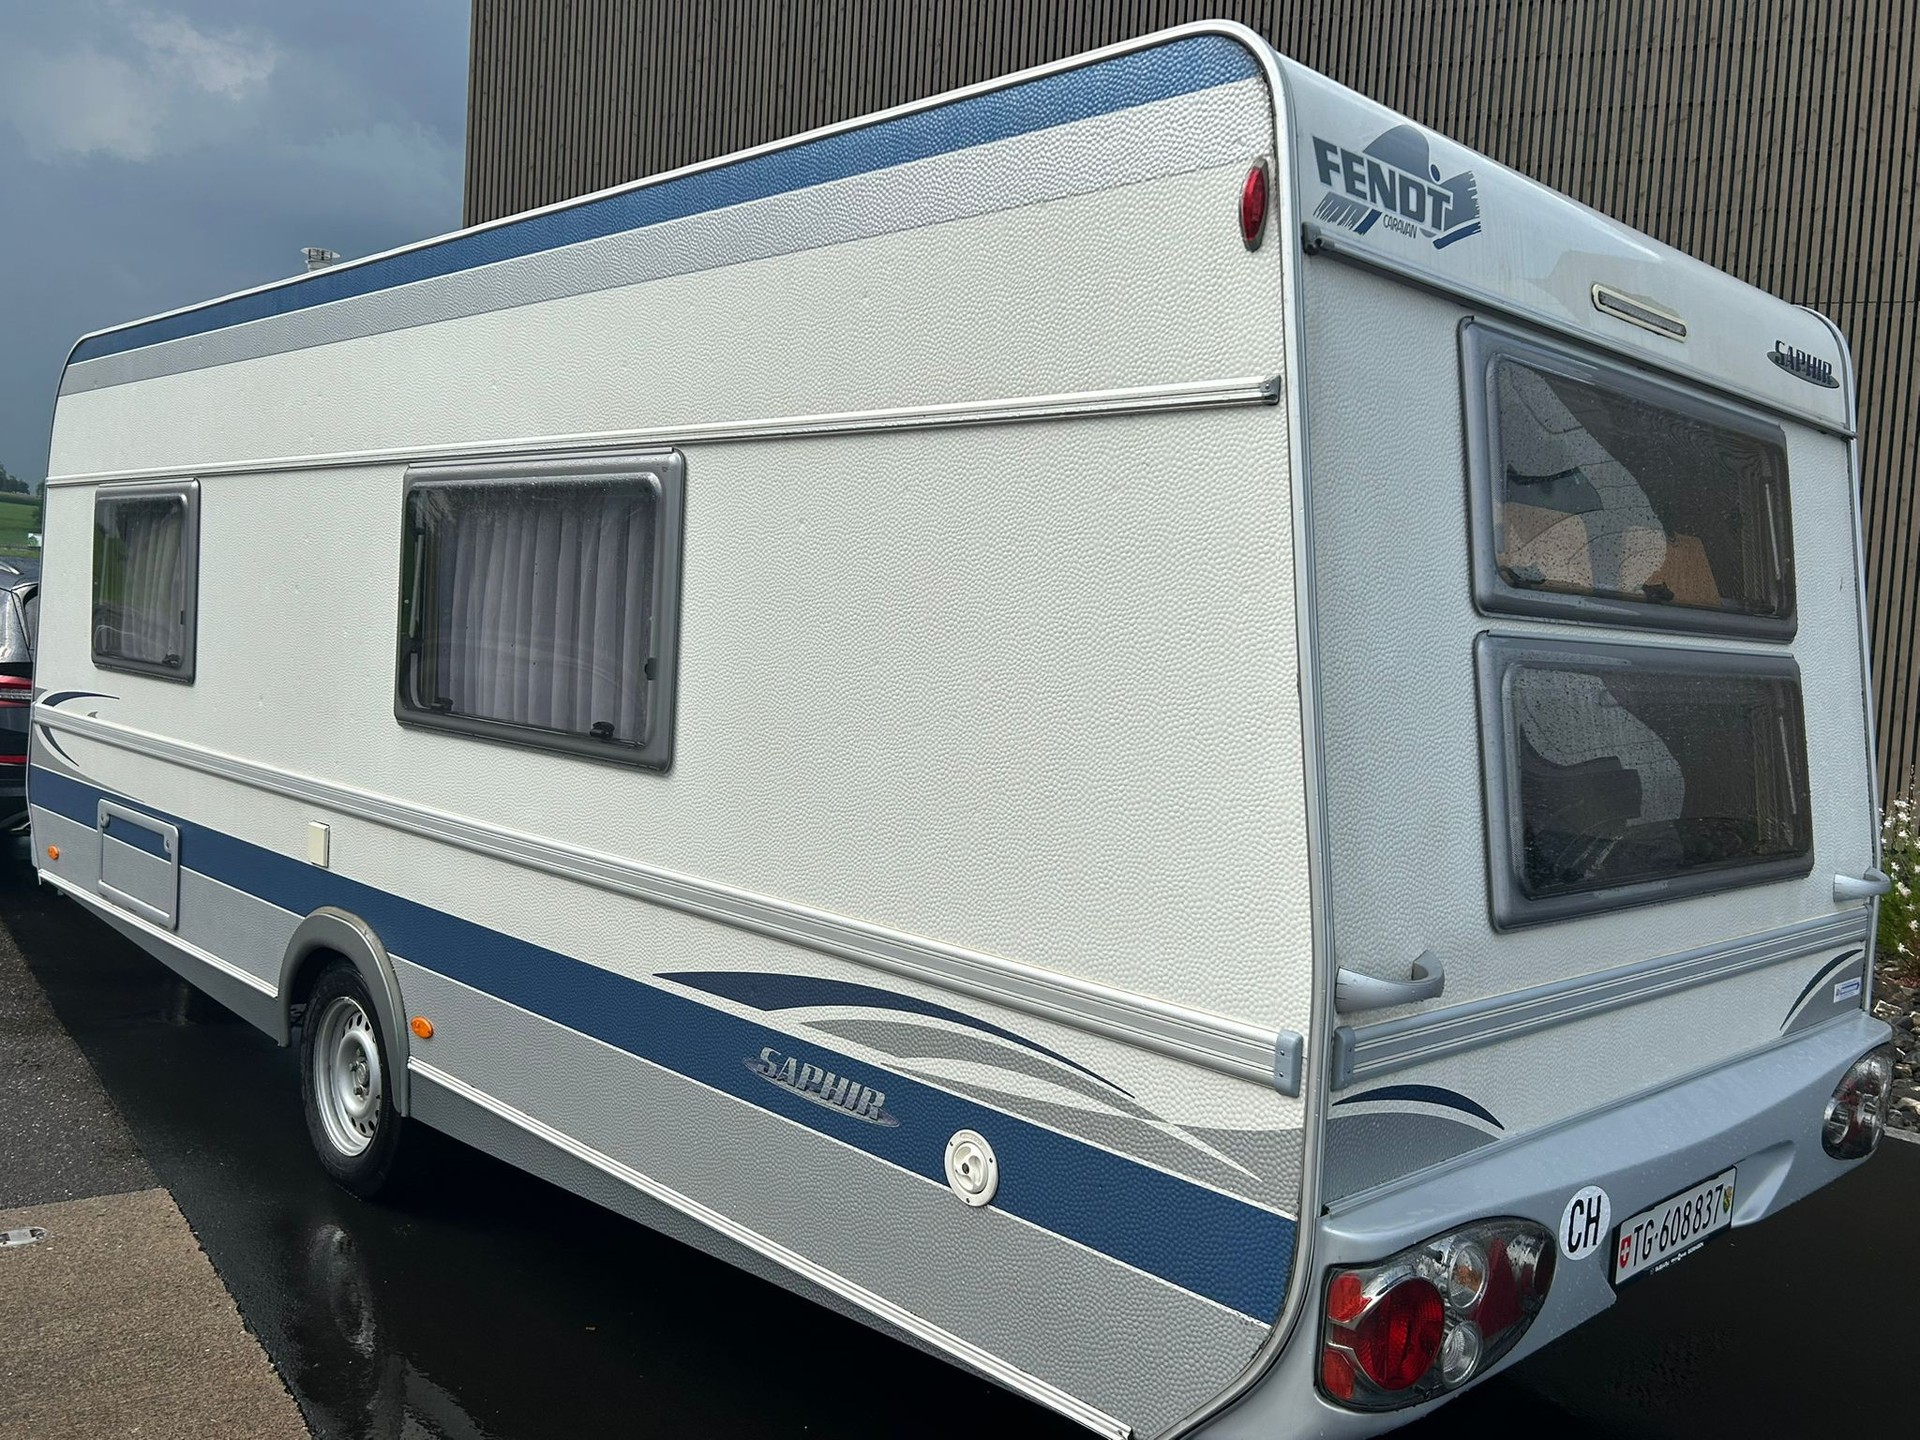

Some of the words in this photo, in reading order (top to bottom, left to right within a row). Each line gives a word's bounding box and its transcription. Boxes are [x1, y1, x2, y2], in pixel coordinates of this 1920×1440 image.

[1312, 136, 1452, 231] FENDT
[1383, 214, 1418, 239] CARAVAN
[1775, 340, 1832, 385] SAPHIR
[756, 1047, 886, 1121] SAPHIR
[1567, 1195, 1601, 1253] CH
